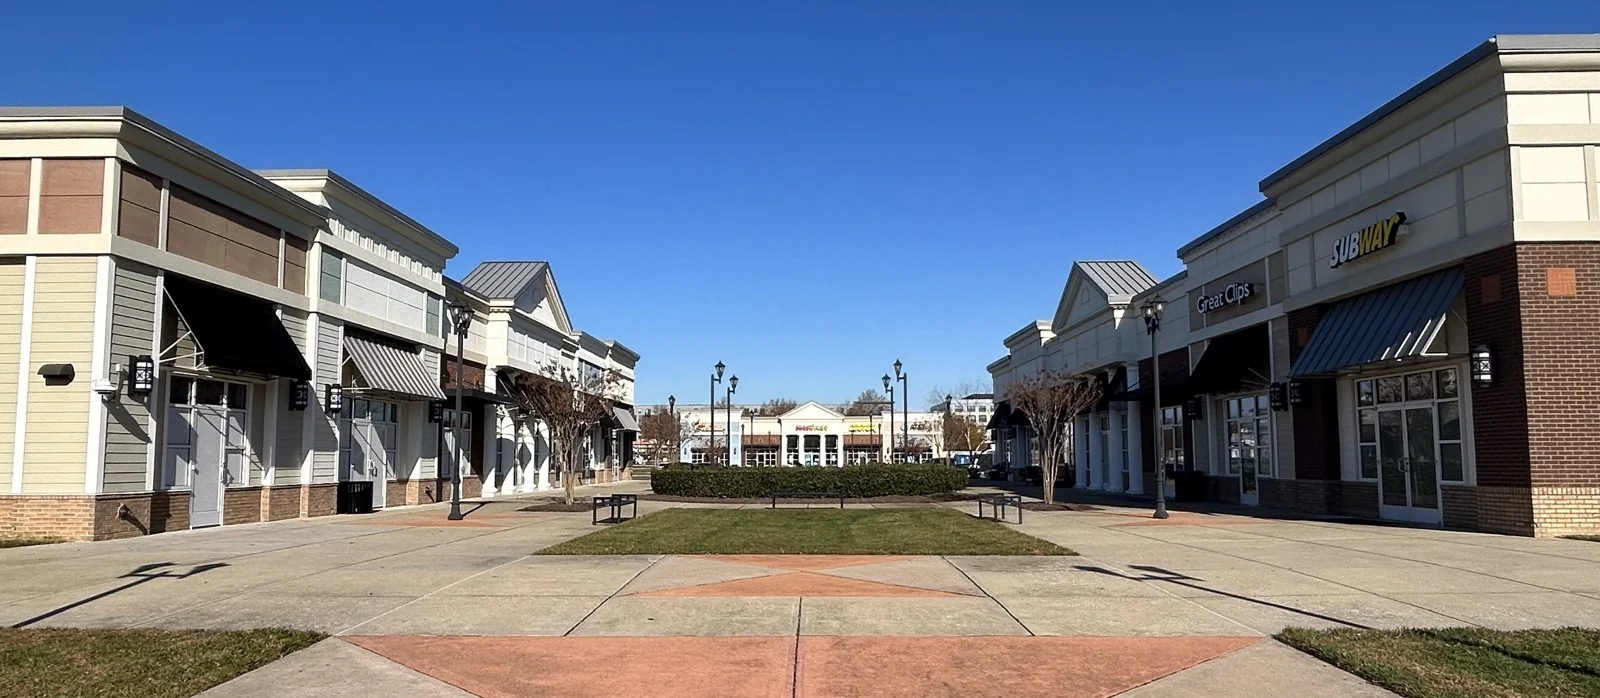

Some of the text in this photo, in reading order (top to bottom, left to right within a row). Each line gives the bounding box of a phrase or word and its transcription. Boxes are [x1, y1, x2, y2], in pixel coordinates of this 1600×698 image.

[1328, 213, 1402, 268] SUBWAY
[1196, 282, 1251, 313] Great Clips
